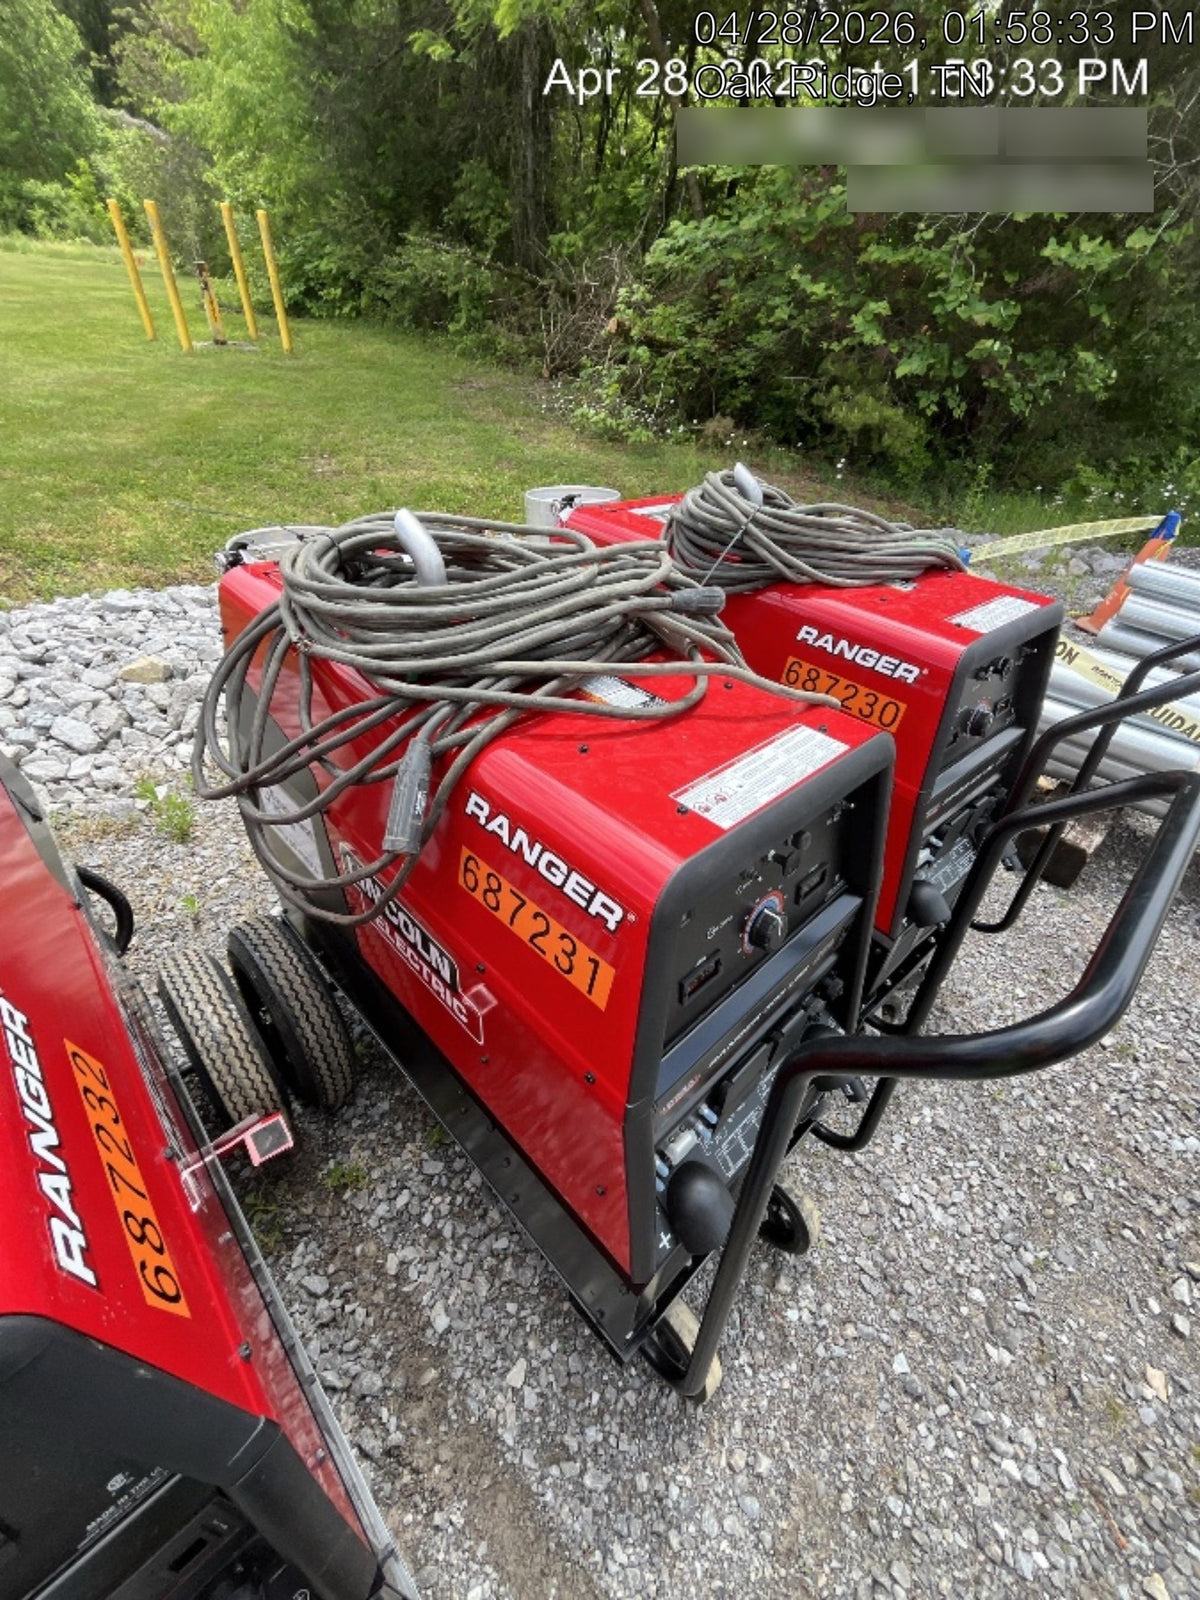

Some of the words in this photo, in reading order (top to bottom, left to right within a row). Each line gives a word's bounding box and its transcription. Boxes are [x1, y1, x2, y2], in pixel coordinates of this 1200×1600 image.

[784, 660, 901, 729] 687230
[795, 624, 922, 685] RANGER
[462, 854, 602, 996] 687231
[463, 790, 627, 934] RANGER
[374, 913, 470, 1025] ELECTRIC
[0, 997, 98, 1289] RANGER
[70, 1050, 183, 1305] 687232
